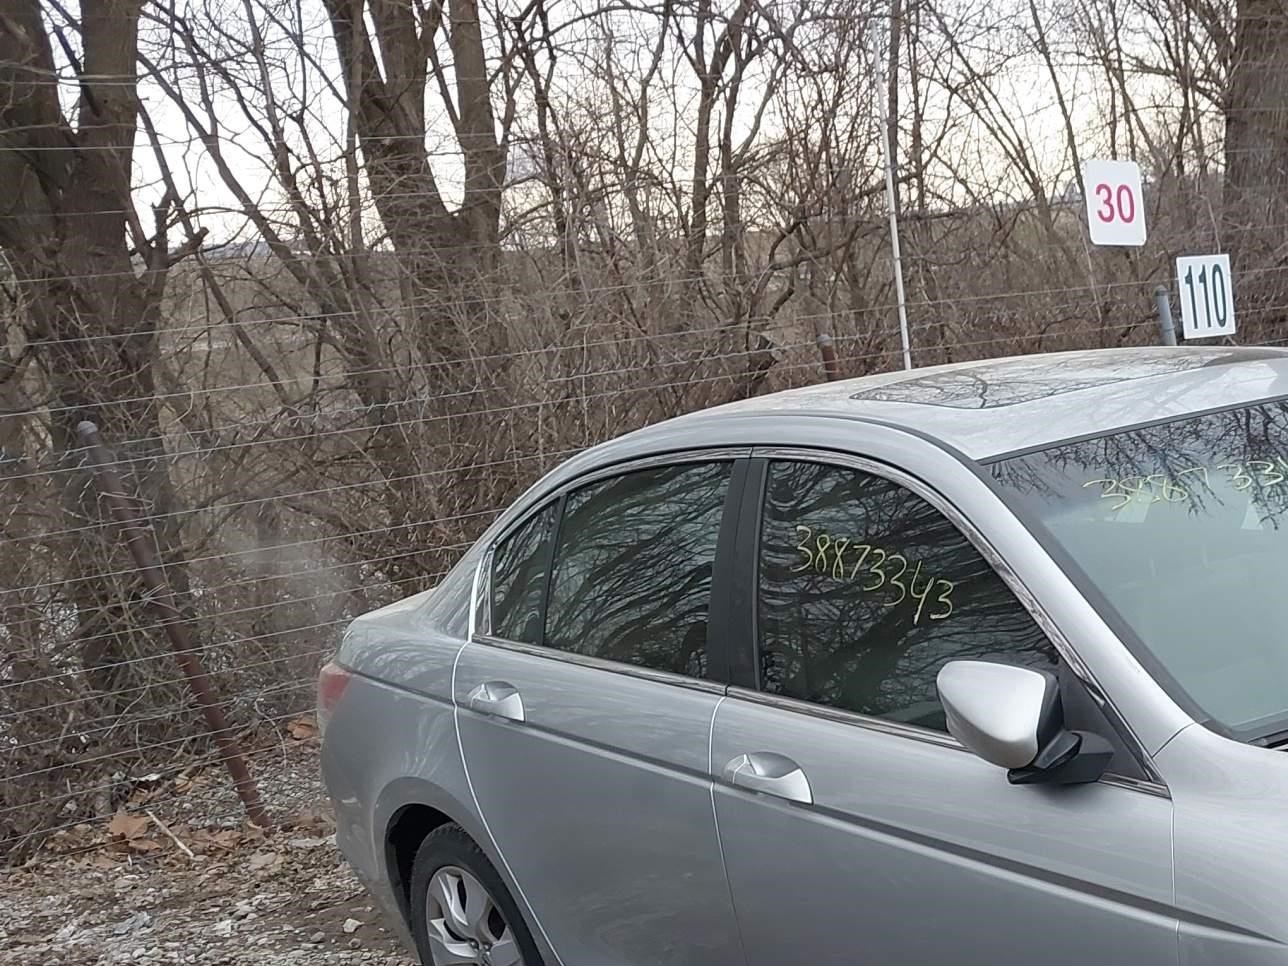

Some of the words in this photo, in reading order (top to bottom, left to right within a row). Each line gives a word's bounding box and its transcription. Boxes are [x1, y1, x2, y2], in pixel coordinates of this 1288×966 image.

[1095, 183, 1135, 224] 30
[1184, 263, 1227, 330] 110
[789, 525, 954, 625] 38873343
